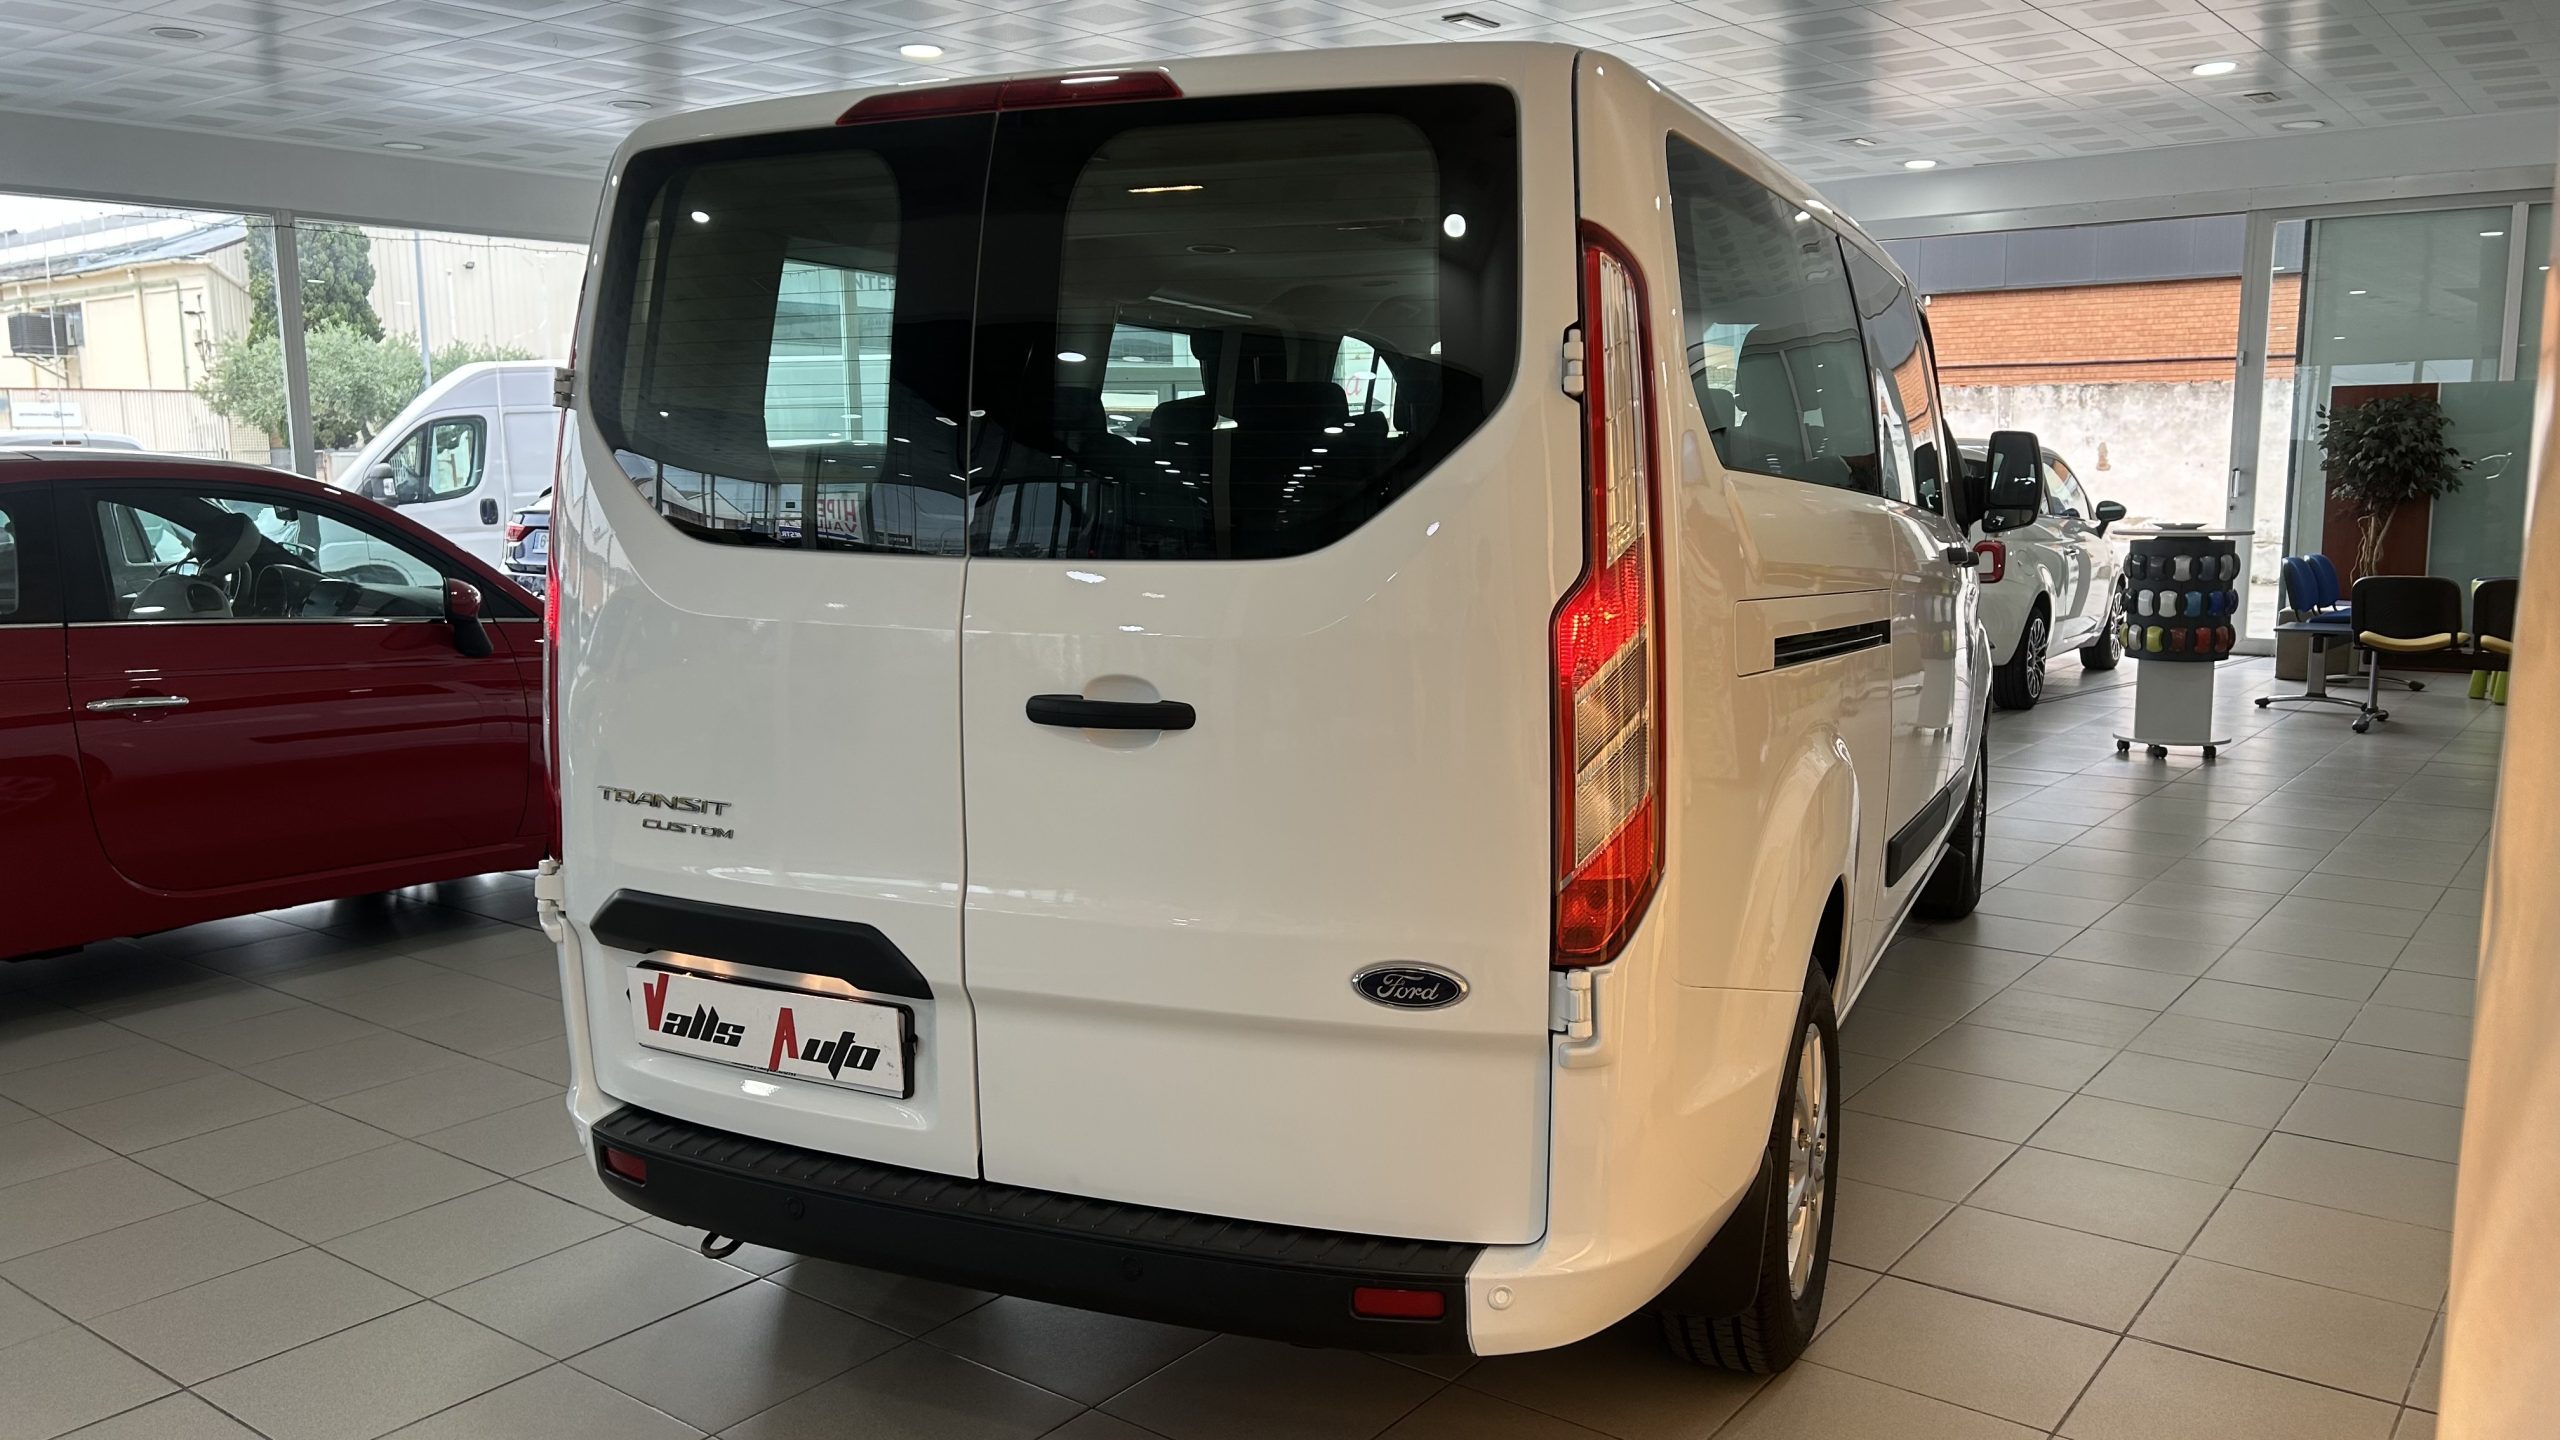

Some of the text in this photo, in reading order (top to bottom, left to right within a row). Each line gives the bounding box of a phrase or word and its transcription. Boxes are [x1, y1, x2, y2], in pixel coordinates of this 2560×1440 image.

[597, 785, 732, 816] TRANSIT
[642, 819, 734, 839] CUSTOM
[1376, 973, 1441, 1000] Ford
[643, 973, 881, 1081] Valls Auto
